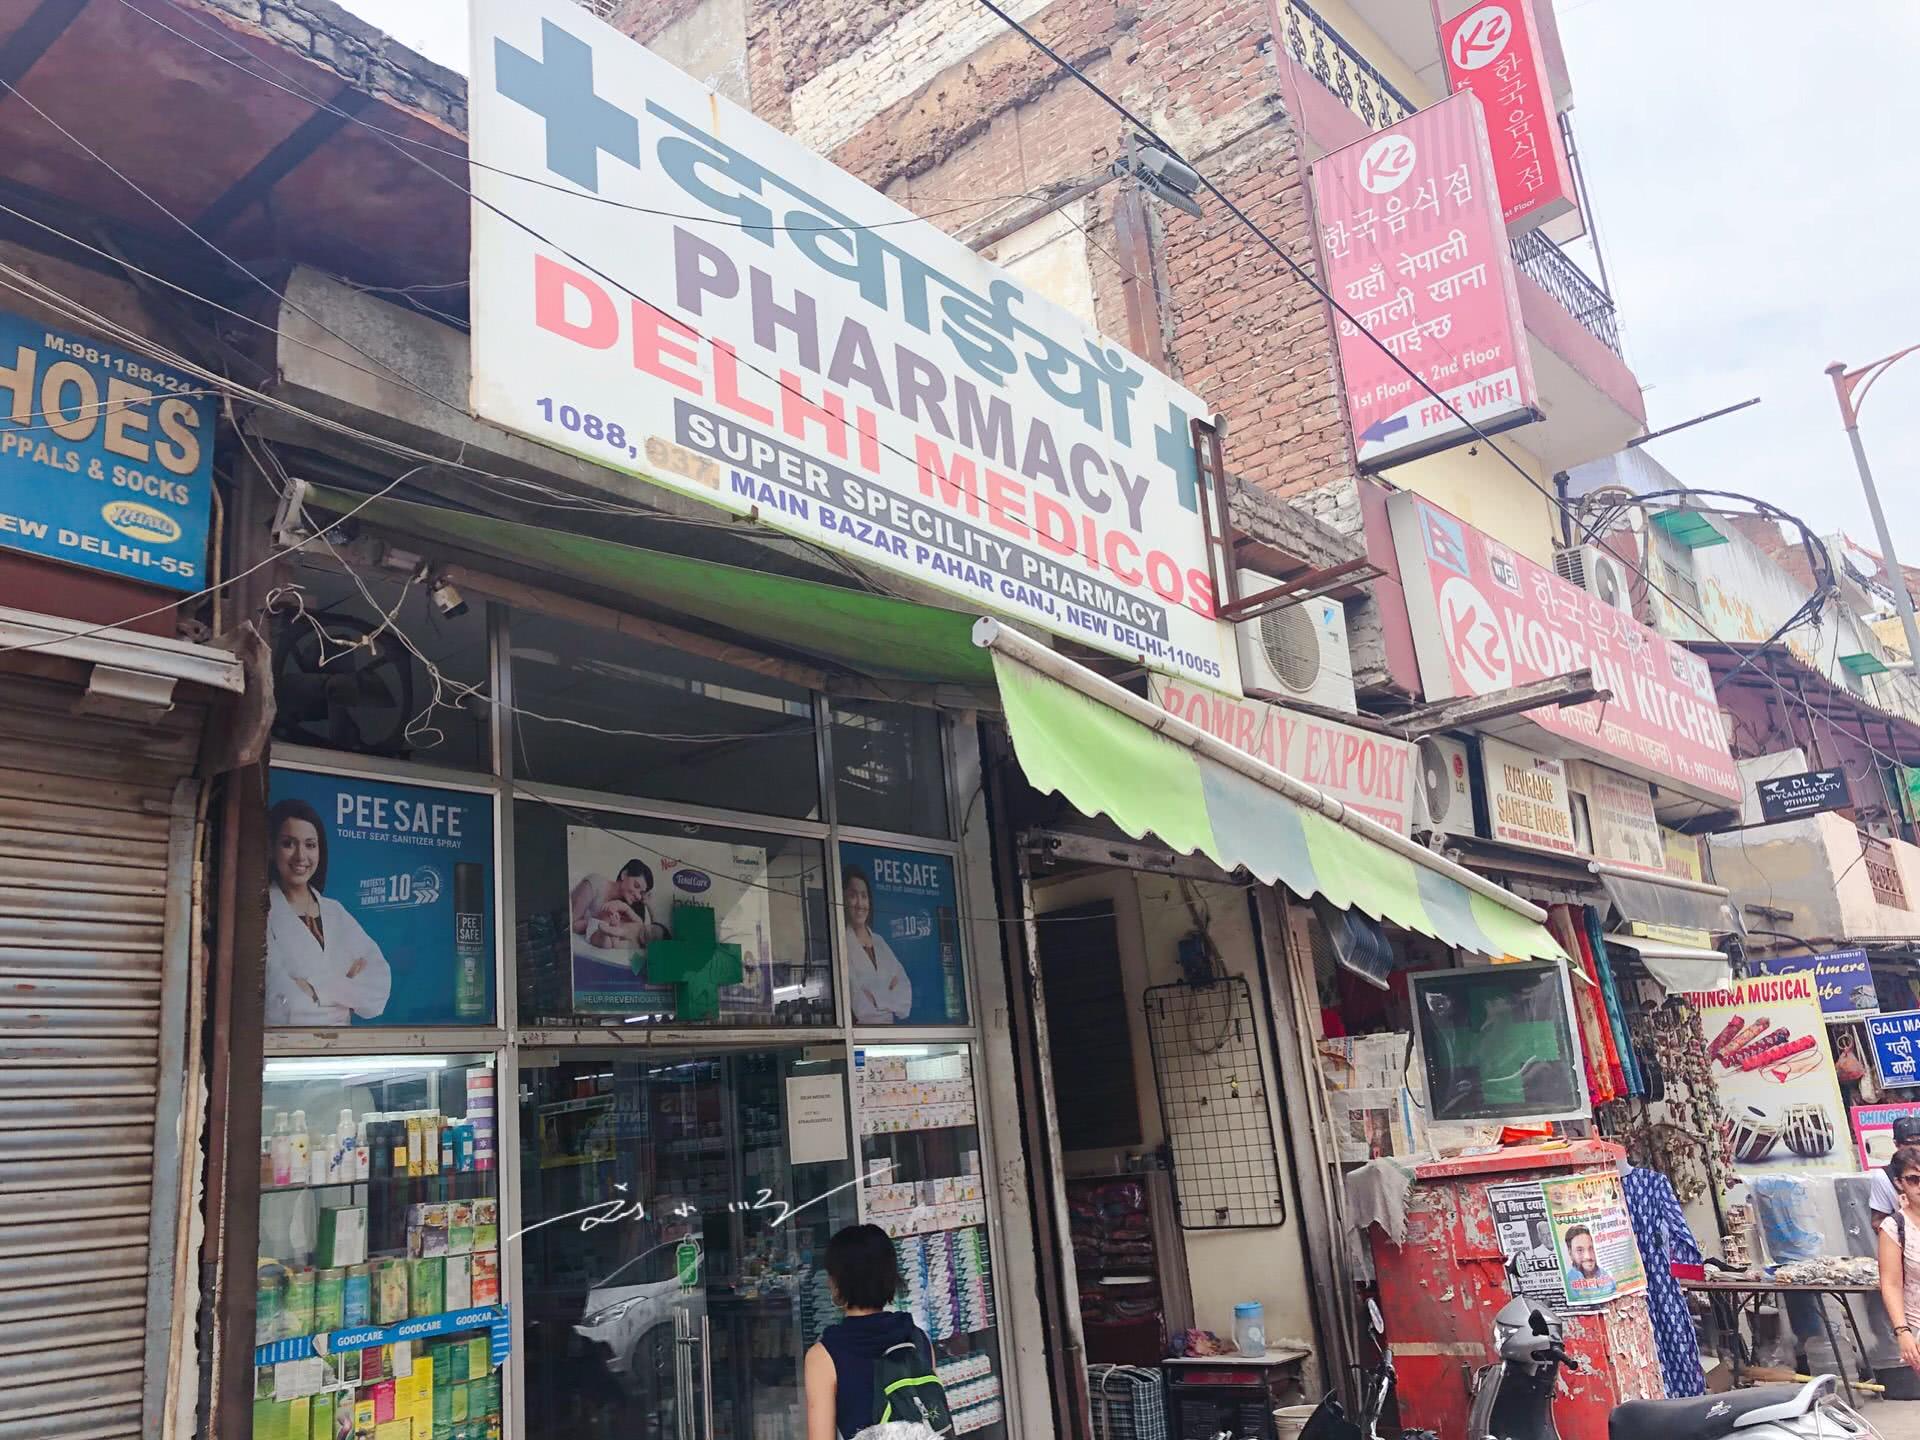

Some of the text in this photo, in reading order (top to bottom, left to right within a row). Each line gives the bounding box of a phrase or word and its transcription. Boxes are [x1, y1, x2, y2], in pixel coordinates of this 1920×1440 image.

[1492, 52, 1545, 192] 한국음식점
[1324, 162, 1473, 260] 한국음식점
[1514, 198, 1537, 215] Floor
[1345, 229, 1469, 301] यहाँ नेपाली
[1340, 264, 1488, 338] थकाली खाना
[673, 224, 1150, 533] PHARMACY
[1352, 344, 1502, 411] 1st Floor & 2nd Floor
[1420, 378, 1514, 428] FREE WIFI
[534, 252, 1217, 621] DELHI MEDICOS
[536, 396, 638, 460] 1088,
[88, 459, 105, 481] &
[111, 465, 189, 505] SOCKS
[687, 412, 1164, 633] SUPER SPECILITY PHARMACY
[58, 528, 195, 577] DELHI-55
[730, 470, 1221, 679] MAIN BAZAR PAHAR GANJ, NEW DELHI-110055
[1503, 606, 1732, 756] KOREAN KITCHEN
[1163, 686, 1411, 804] BOMBAY EXPORT
[1456, 782, 1466, 794] LG
[1791, 778, 1810, 790] DL
[1819, 782, 1841, 793] CCTV
[335, 792, 463, 837] PEE SAFE
[1534, 803, 1570, 839] HOUSE
[337, 828, 462, 849] TOILET SEAT SANITIZER SPRAY
[388, 872, 412, 902] 10
[874, 859, 939, 888] PEE SAFE
[459, 928, 480, 941] SAFE
[461, 916, 477, 929] PEE
[905, 916, 917, 936] 10
[1747, 978, 1811, 1003] MUSICAL
[1816, 981, 1843, 999] ife
[1872, 1020, 1902, 1036] GALI
[337, 1330, 384, 1347] GOODCARE
[398, 1320, 442, 1336] GOODCARE
